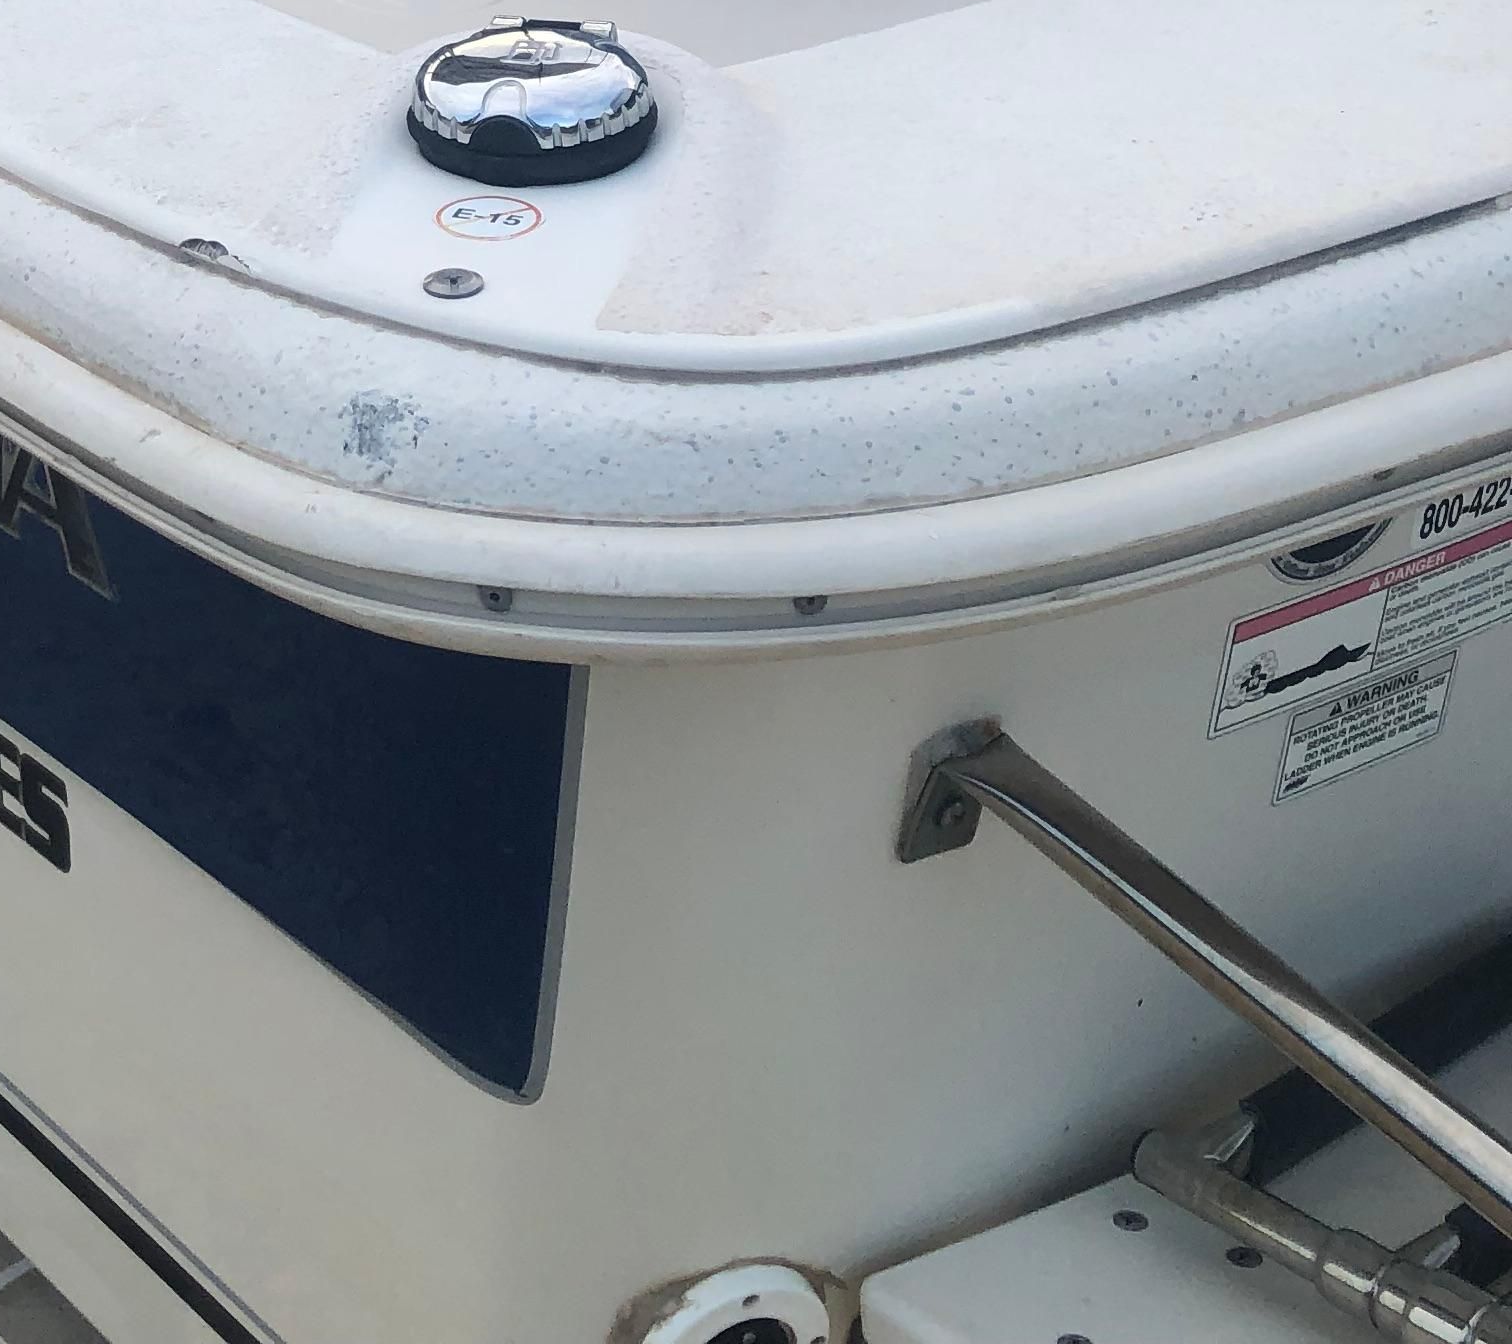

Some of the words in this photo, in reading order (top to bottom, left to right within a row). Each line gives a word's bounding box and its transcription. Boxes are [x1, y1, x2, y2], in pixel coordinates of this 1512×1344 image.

[451, 207, 524, 226] E-15
[1419, 477, 1512, 540] 800-422
[1384, 551, 1446, 586] DANGER
[1293, 720, 1340, 746] ROTATING
[1341, 696, 1395, 727] PROPELLER
[1396, 688, 1416, 704] MAY
[1416, 674, 1447, 695] CAUSE
[1346, 670, 1420, 710] WARNING
[1304, 750, 1319, 763] DO
[1319, 741, 1340, 756] NOT
[1341, 719, 1392, 747] APPROACH
[1393, 714, 1407, 725] OR
[1306, 727, 1347, 751] SERIOUS
[1347, 714, 1380, 734] INJURY
[1382, 708, 1396, 720] OR
[1284, 759, 1322, 782] LADDER
[1323, 748, 1351, 765] WHEN
[1352, 732, 1386, 753] ENGINE
